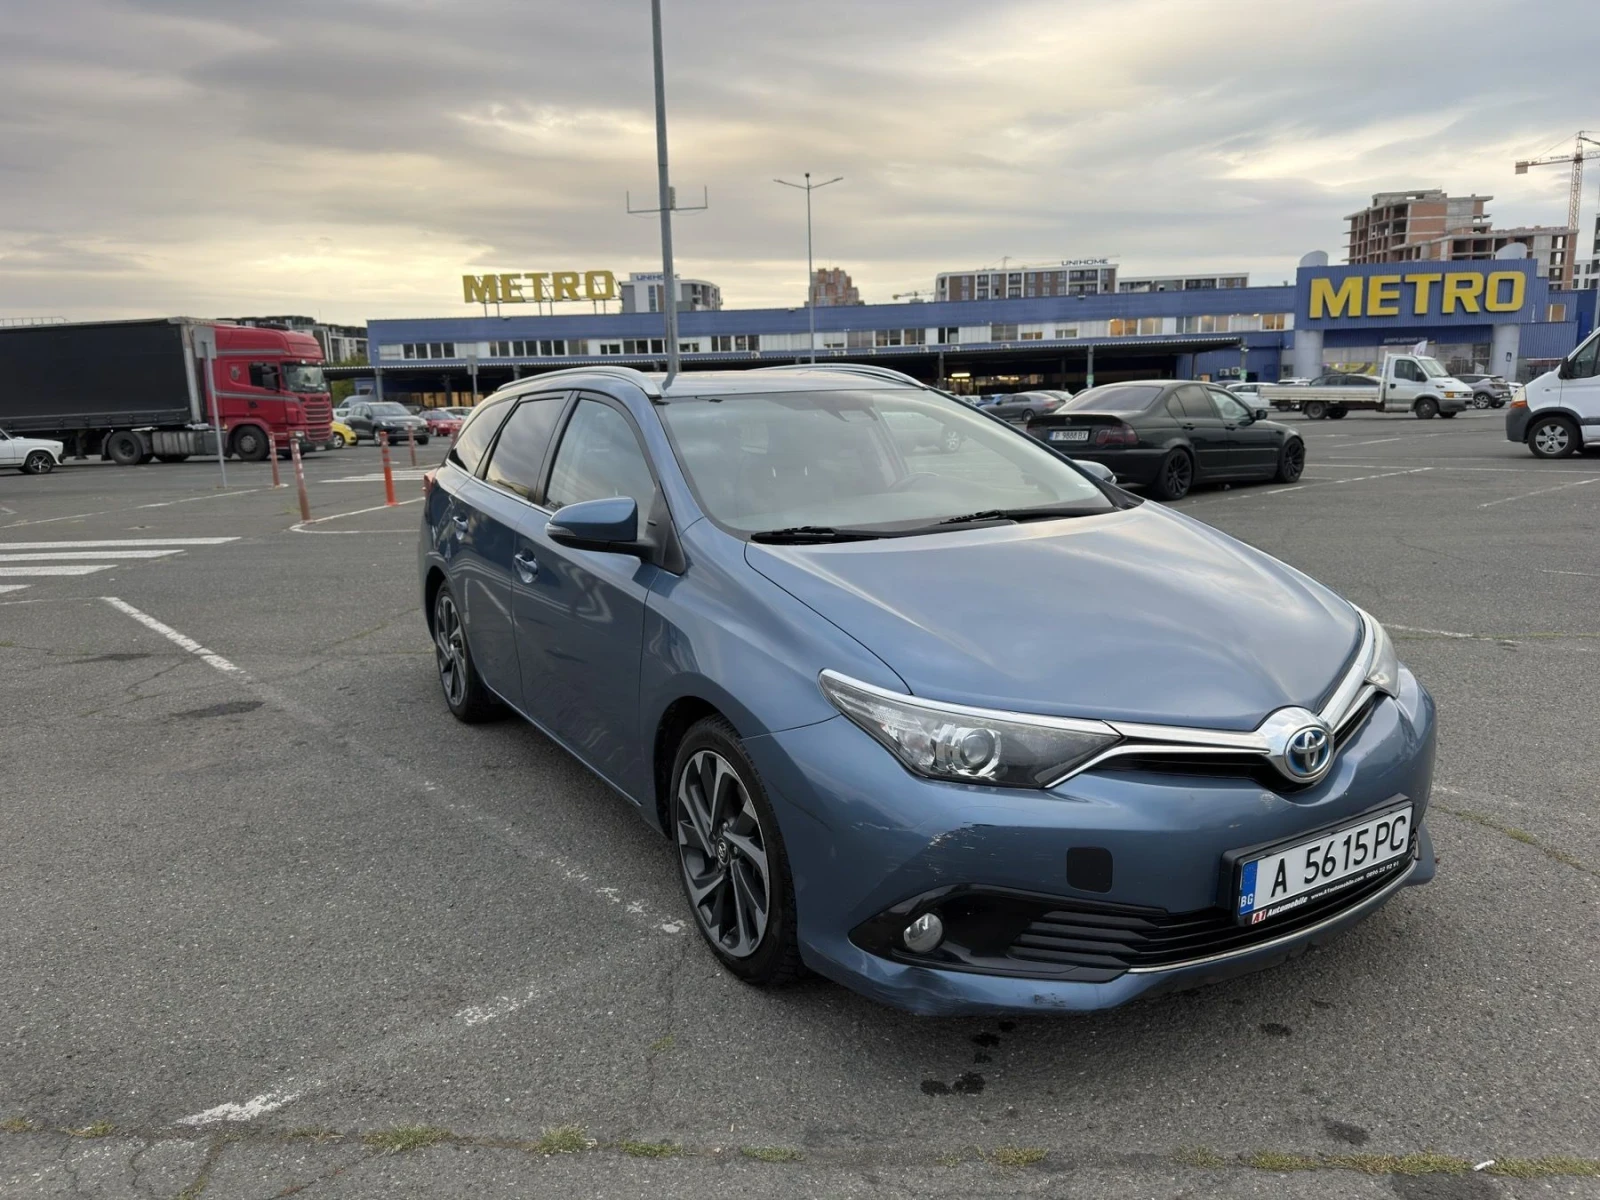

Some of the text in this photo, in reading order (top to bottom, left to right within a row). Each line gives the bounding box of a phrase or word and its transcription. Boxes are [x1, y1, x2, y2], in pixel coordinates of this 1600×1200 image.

[1061, 259, 1109, 267] UNIHOME
[463, 270, 615, 304] METRO
[1309, 271, 1526, 319] METRO
[1270, 858, 1288, 898] A
[1240, 893, 1254, 908] BG
[1252, 910, 1267, 924] A1
